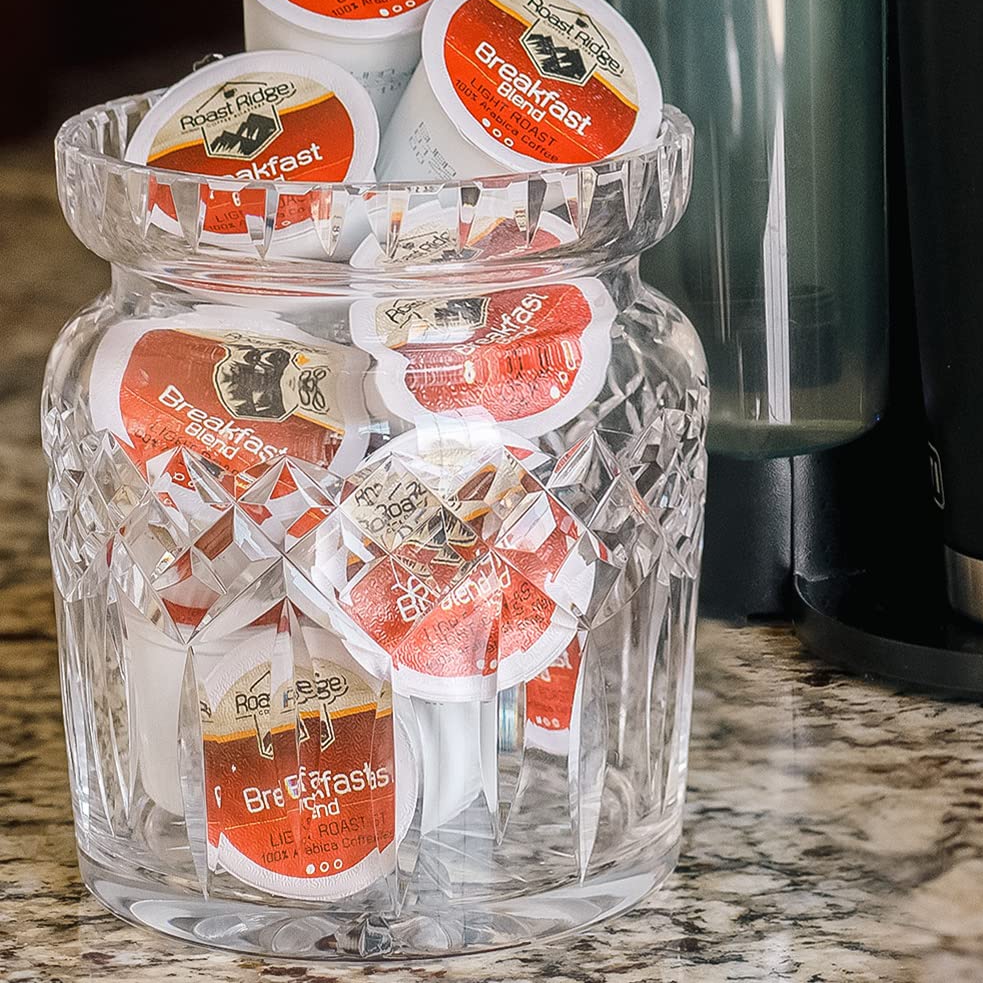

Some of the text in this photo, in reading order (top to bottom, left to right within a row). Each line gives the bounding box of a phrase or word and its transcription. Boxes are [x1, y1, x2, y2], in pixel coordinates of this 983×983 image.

[331, 0, 359, 17] 100%
[574, 30, 621, 73] Ridge
[179, 102, 234, 130] Roast
[236, 82, 291, 112] Ridge
[470, 77, 558, 147] LIGHT ROAST
[474, 41, 592, 137] Breakfast
[496, 80, 547, 124] Blend
[455, 79, 559, 162] 100% Arabica Coffee
[224, 142, 324, 181] akfast
[452, 292, 549, 356] Breakfast
[158, 384, 289, 463] Breakfast
[185, 422, 240, 460] Blend
[318, 815, 367, 839] ROAST
